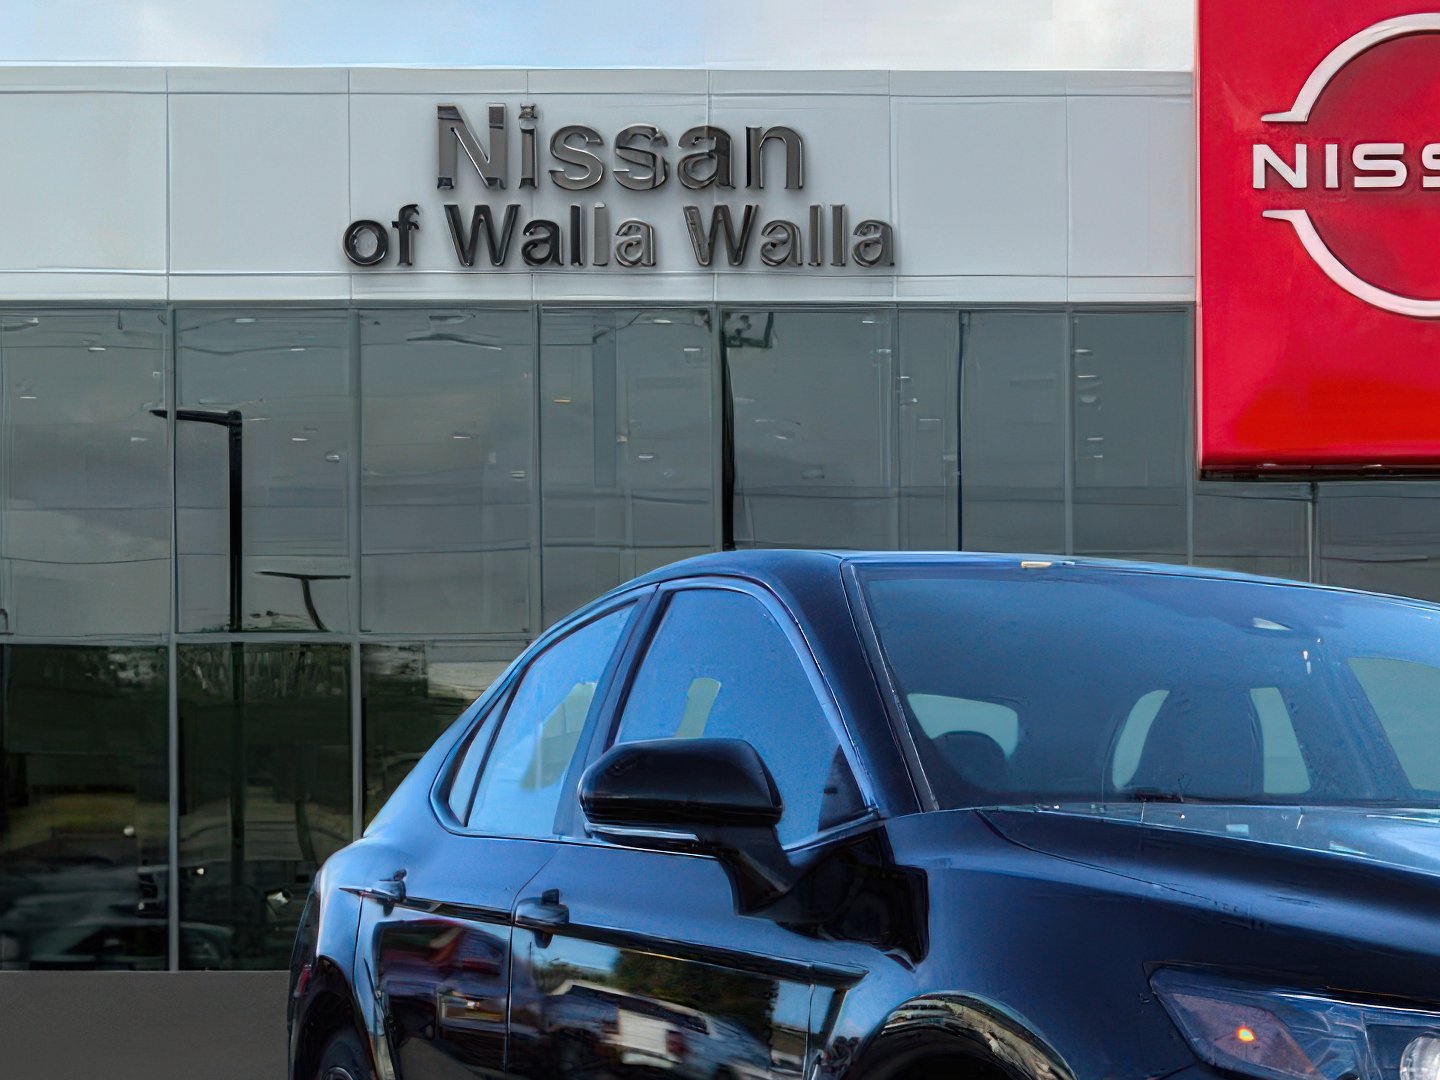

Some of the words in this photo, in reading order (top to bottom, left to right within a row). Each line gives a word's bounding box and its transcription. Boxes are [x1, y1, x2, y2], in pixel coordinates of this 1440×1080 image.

[437, 103, 804, 191] Nissan
[342, 203, 421, 267] of
[444, 203, 657, 267] Walla
[683, 204, 895, 268] Walla
